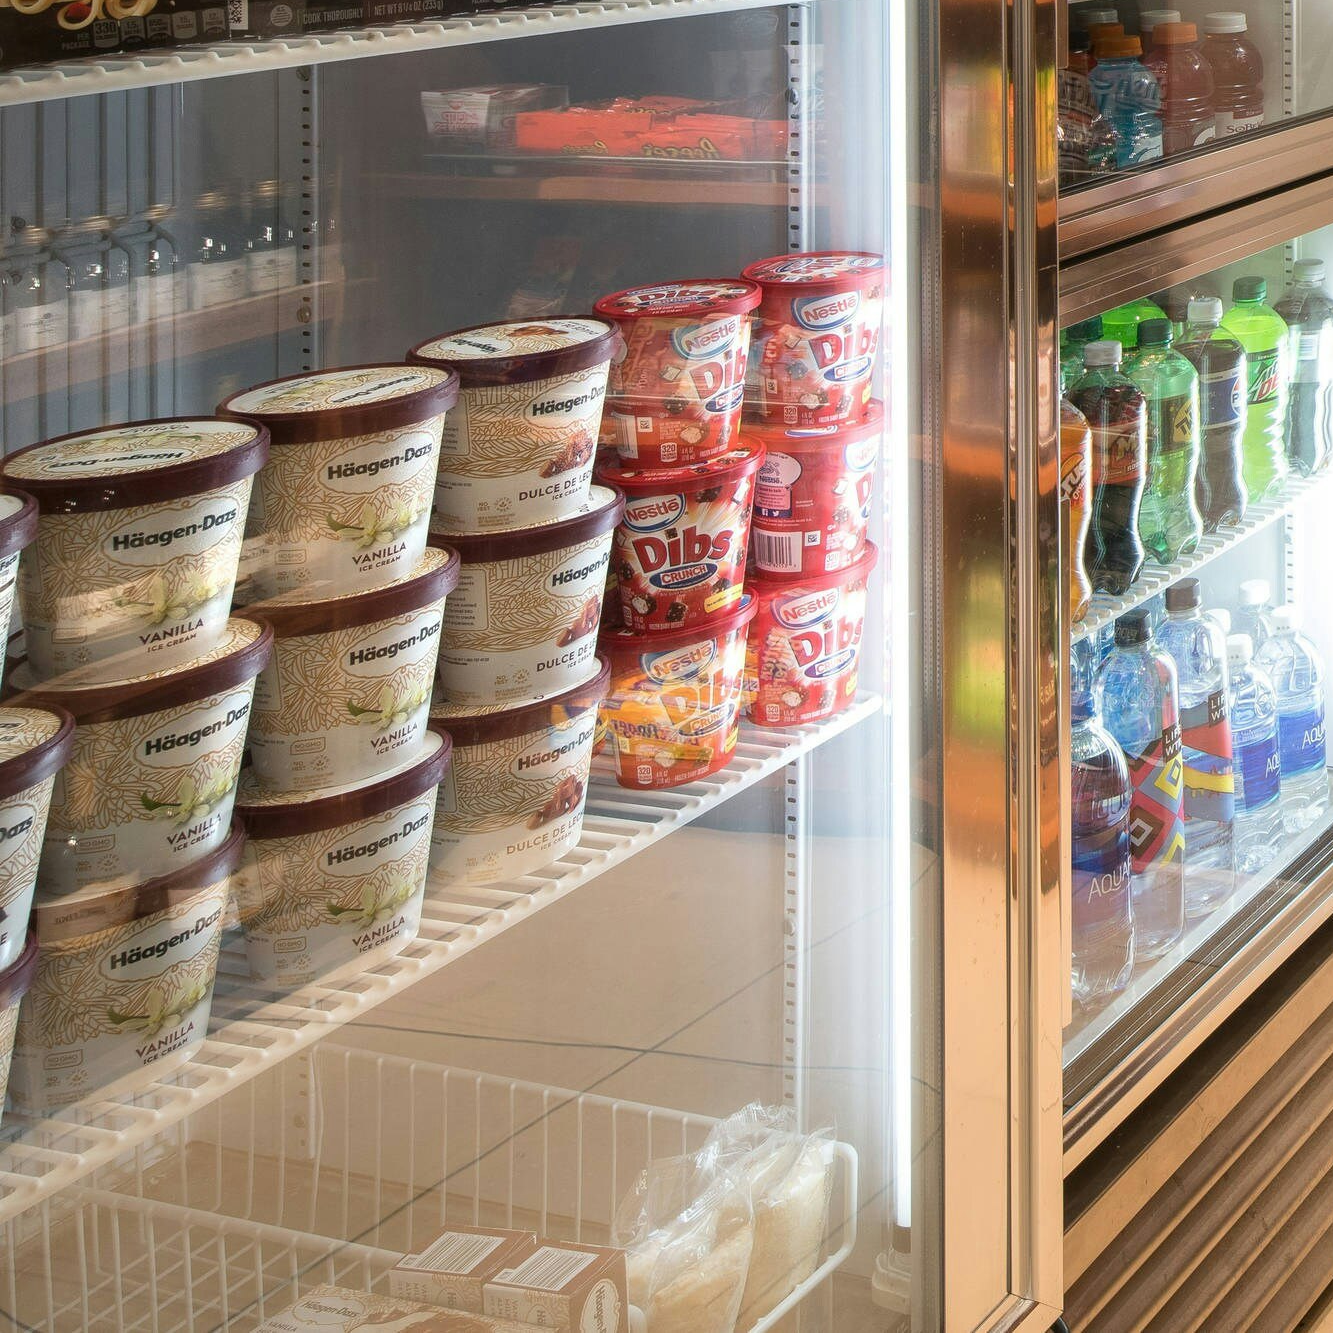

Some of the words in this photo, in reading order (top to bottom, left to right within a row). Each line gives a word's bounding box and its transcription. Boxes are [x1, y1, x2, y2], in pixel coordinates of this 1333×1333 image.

[327, 441, 433, 481] Häagen-Dazs
[519, 482, 561, 501] DULCE
[563, 476, 577, 491] DE
[112, 507, 237, 552] Häagen-Dazs
[351, 541, 407, 566] VANILLA
[632, 527, 734, 573] Dibs
[661, 565, 707, 585] CRUNCH
[139, 617, 204, 646] VANILLA
[147, 641, 165, 653] ICE
[167, 632, 197, 650] CREAM
[790, 617, 865, 668] Dibs
[144, 702, 251, 758] Häagen-Dazs
[327, 812, 430, 866] Häagen-Dazs
[352, 915, 406, 947] VANILLA
